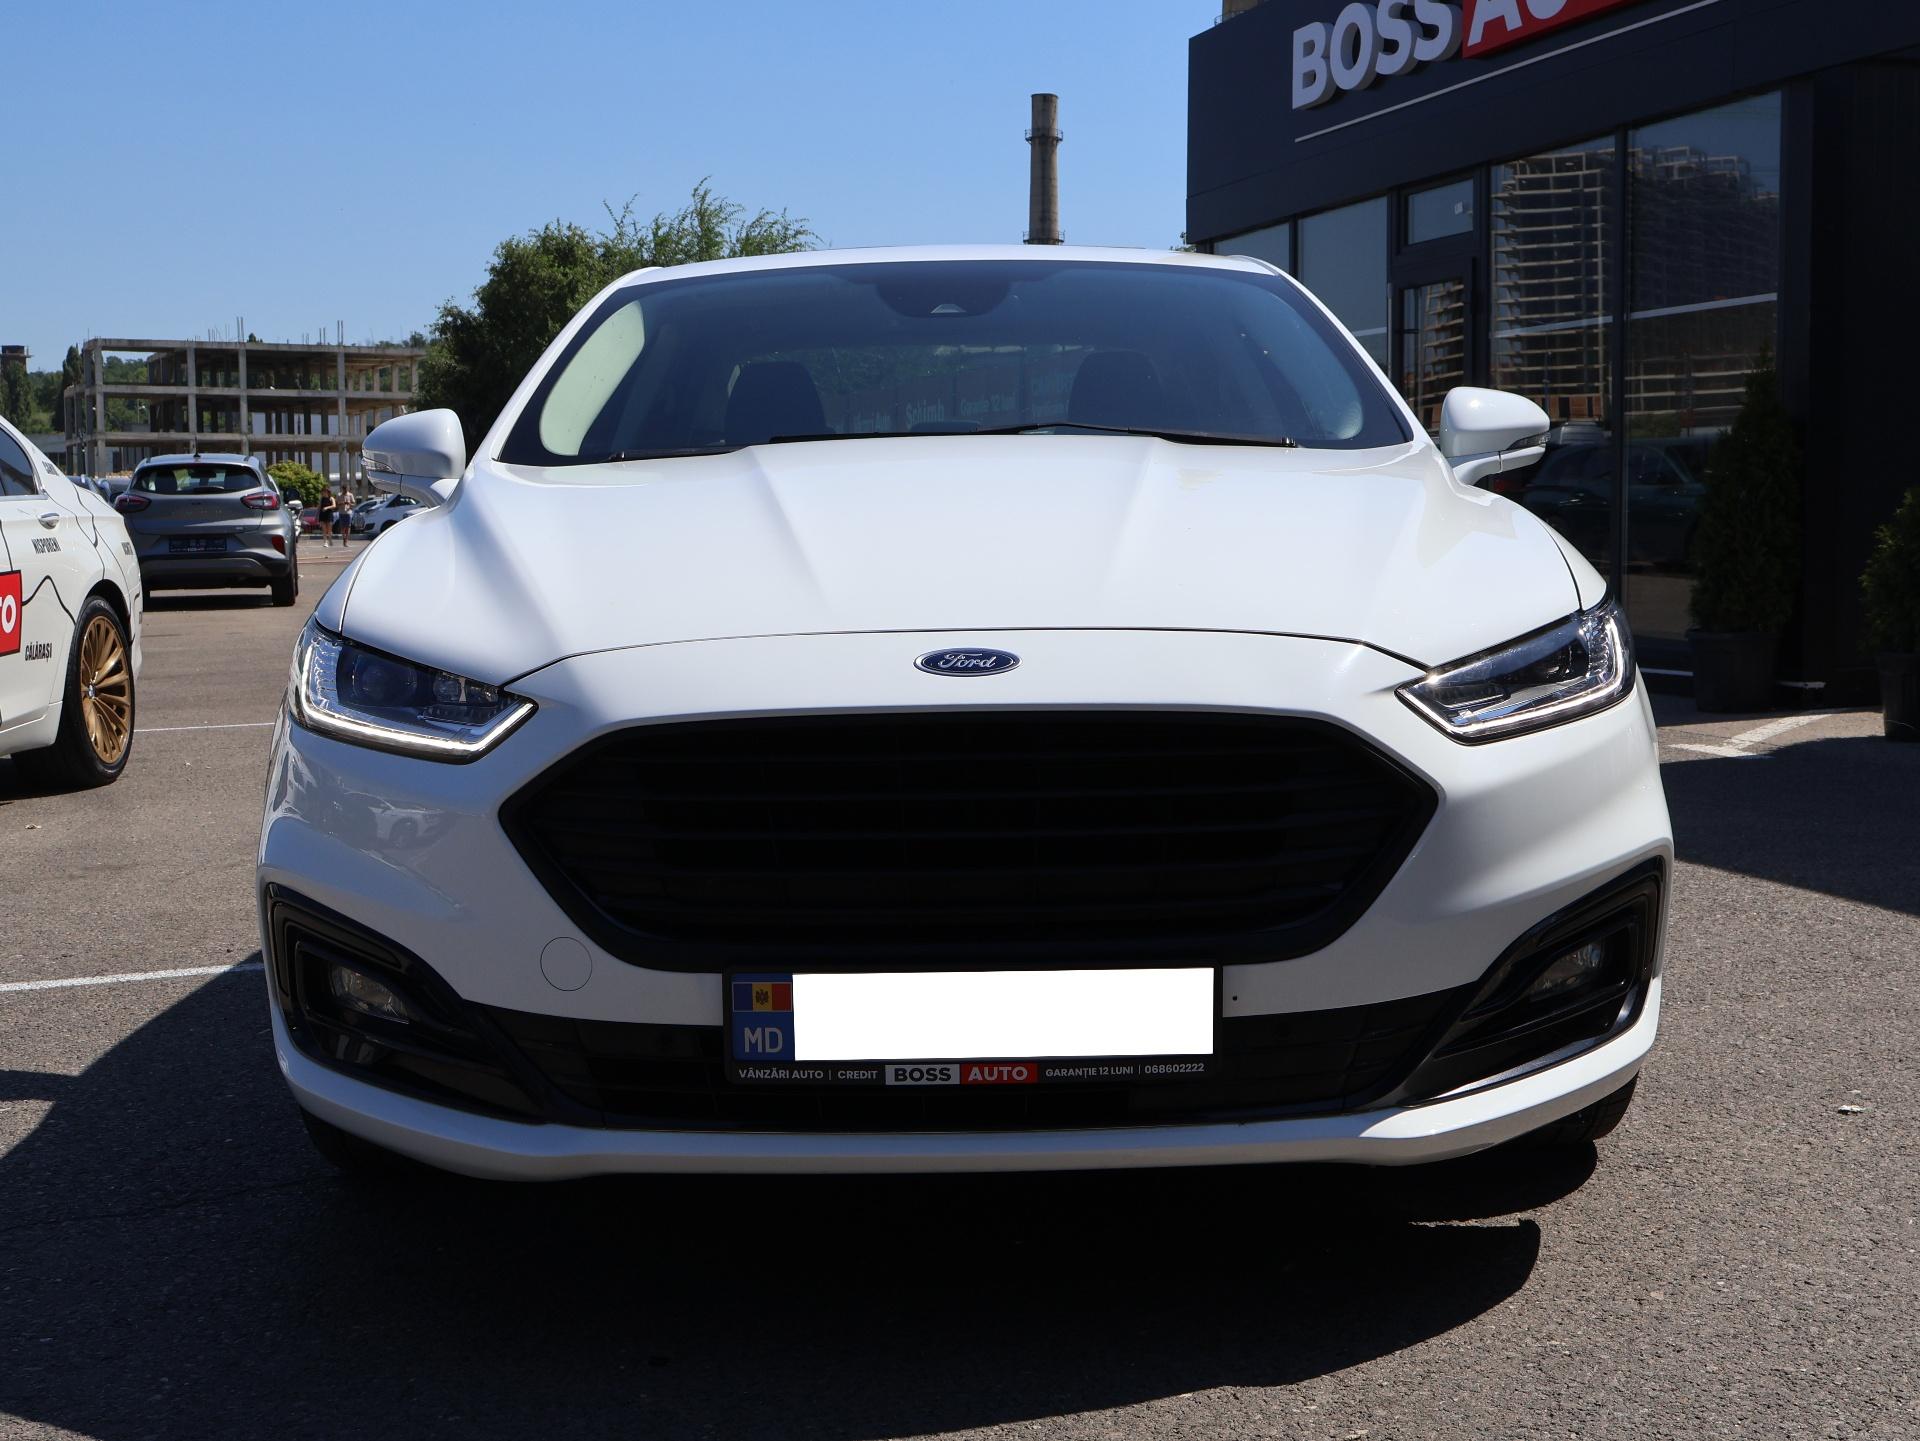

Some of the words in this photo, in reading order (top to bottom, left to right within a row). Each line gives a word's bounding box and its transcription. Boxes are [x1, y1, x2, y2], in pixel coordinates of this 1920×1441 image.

[1293, 0, 1457, 110] BOSS
[938, 653, 997, 669] Ford
[744, 1027, 783, 1053] MD
[739, 1067, 789, 1079] VÂNZĂRI
[792, 1070, 824, 1079] AUTO
[838, 1070, 878, 1080] CREDIT
[894, 1067, 952, 1082] BOSS
[968, 1066, 1028, 1081] AUTO
[1099, 1066, 1110, 1076] 12
[1111, 1066, 1134, 1075] LUNI
[1144, 1063, 1205, 1074] 068602222
